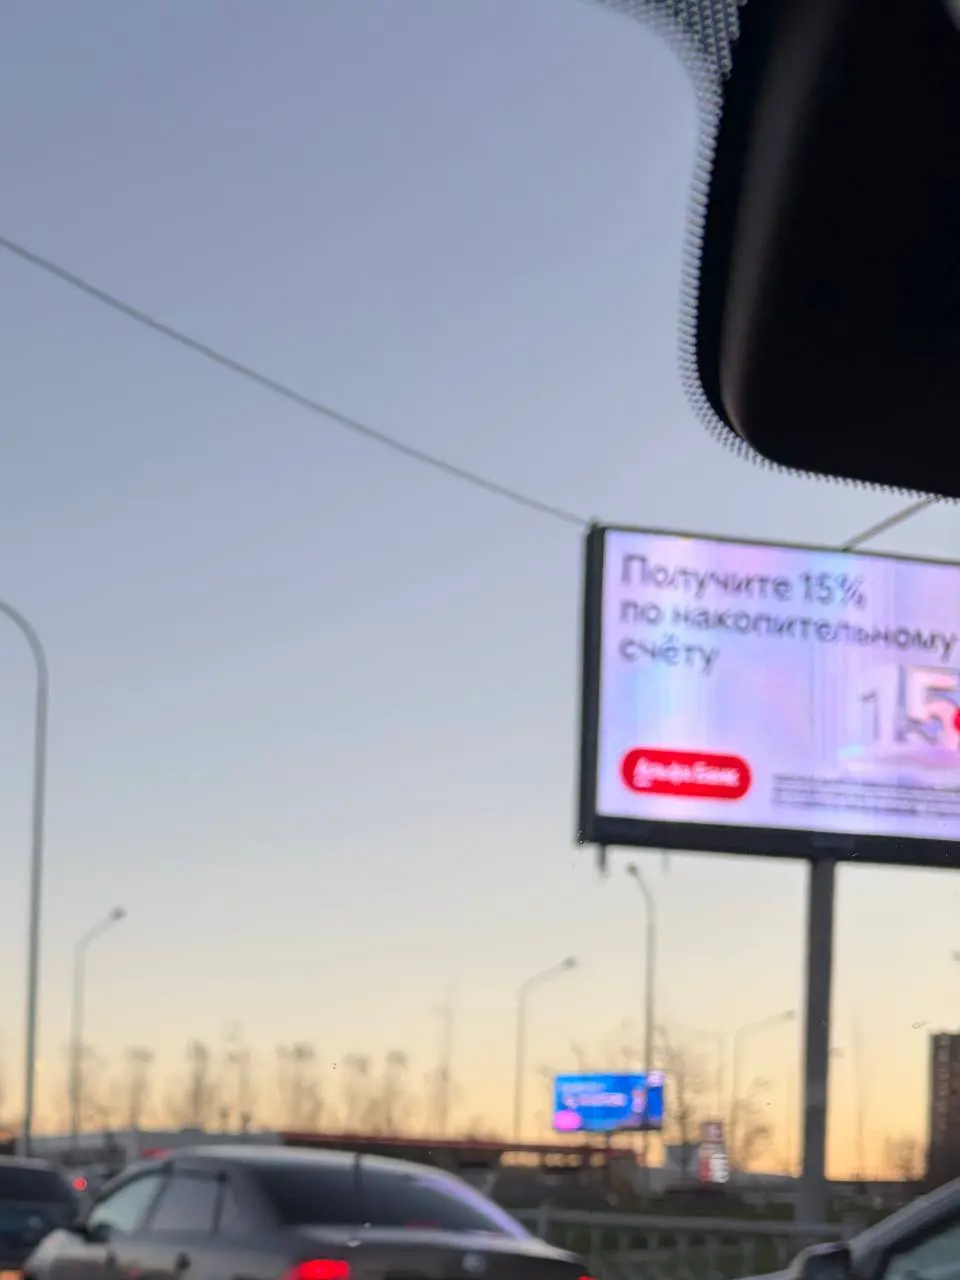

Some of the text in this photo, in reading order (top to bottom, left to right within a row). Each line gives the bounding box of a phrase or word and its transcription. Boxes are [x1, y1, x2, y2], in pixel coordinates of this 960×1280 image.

[620, 553, 868, 610] Получите 15%
[618, 600, 958, 663] по накопительному
[618, 631, 721, 678] счёту
